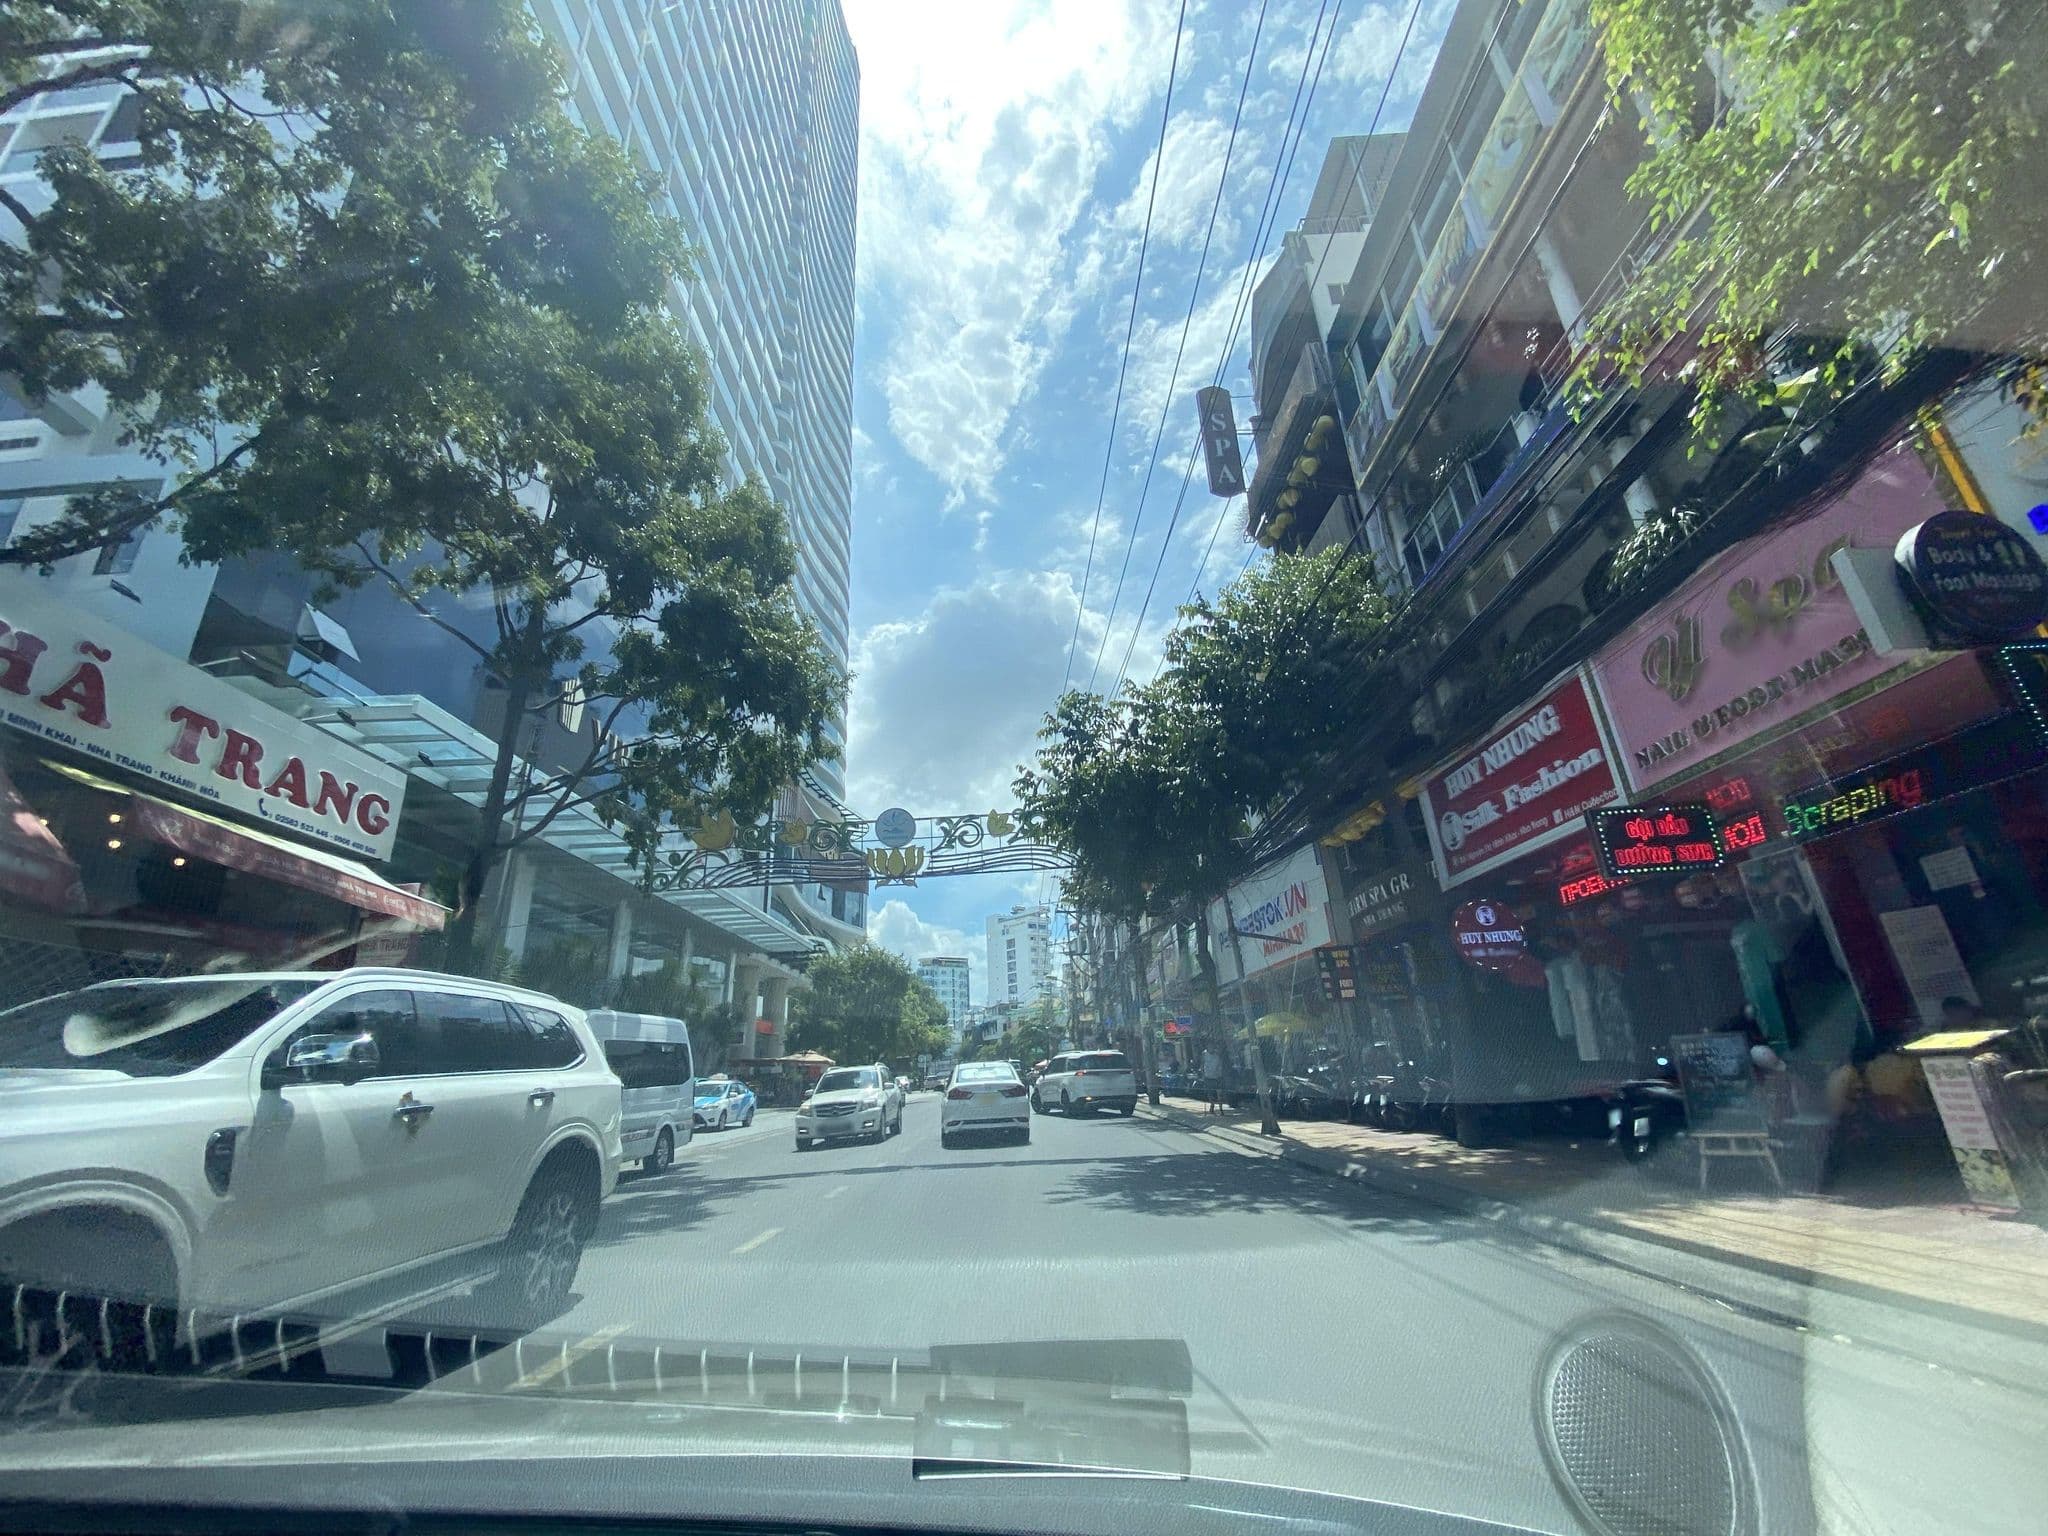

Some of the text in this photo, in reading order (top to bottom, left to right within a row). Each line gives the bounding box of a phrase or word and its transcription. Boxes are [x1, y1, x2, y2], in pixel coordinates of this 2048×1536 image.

[1211, 413, 1237, 483] SPA
[45, 724, 78, 746] KHAI
[86, 742, 112, 761] NHA
[115, 753, 154, 774] TRANG
[168, 705, 391, 836] TRANG
[1444, 703, 1561, 800] HUY NHUNG
[1502, 747, 1602, 812] Fashion
[1460, 930, 1522, 944] HUY NHUNG
